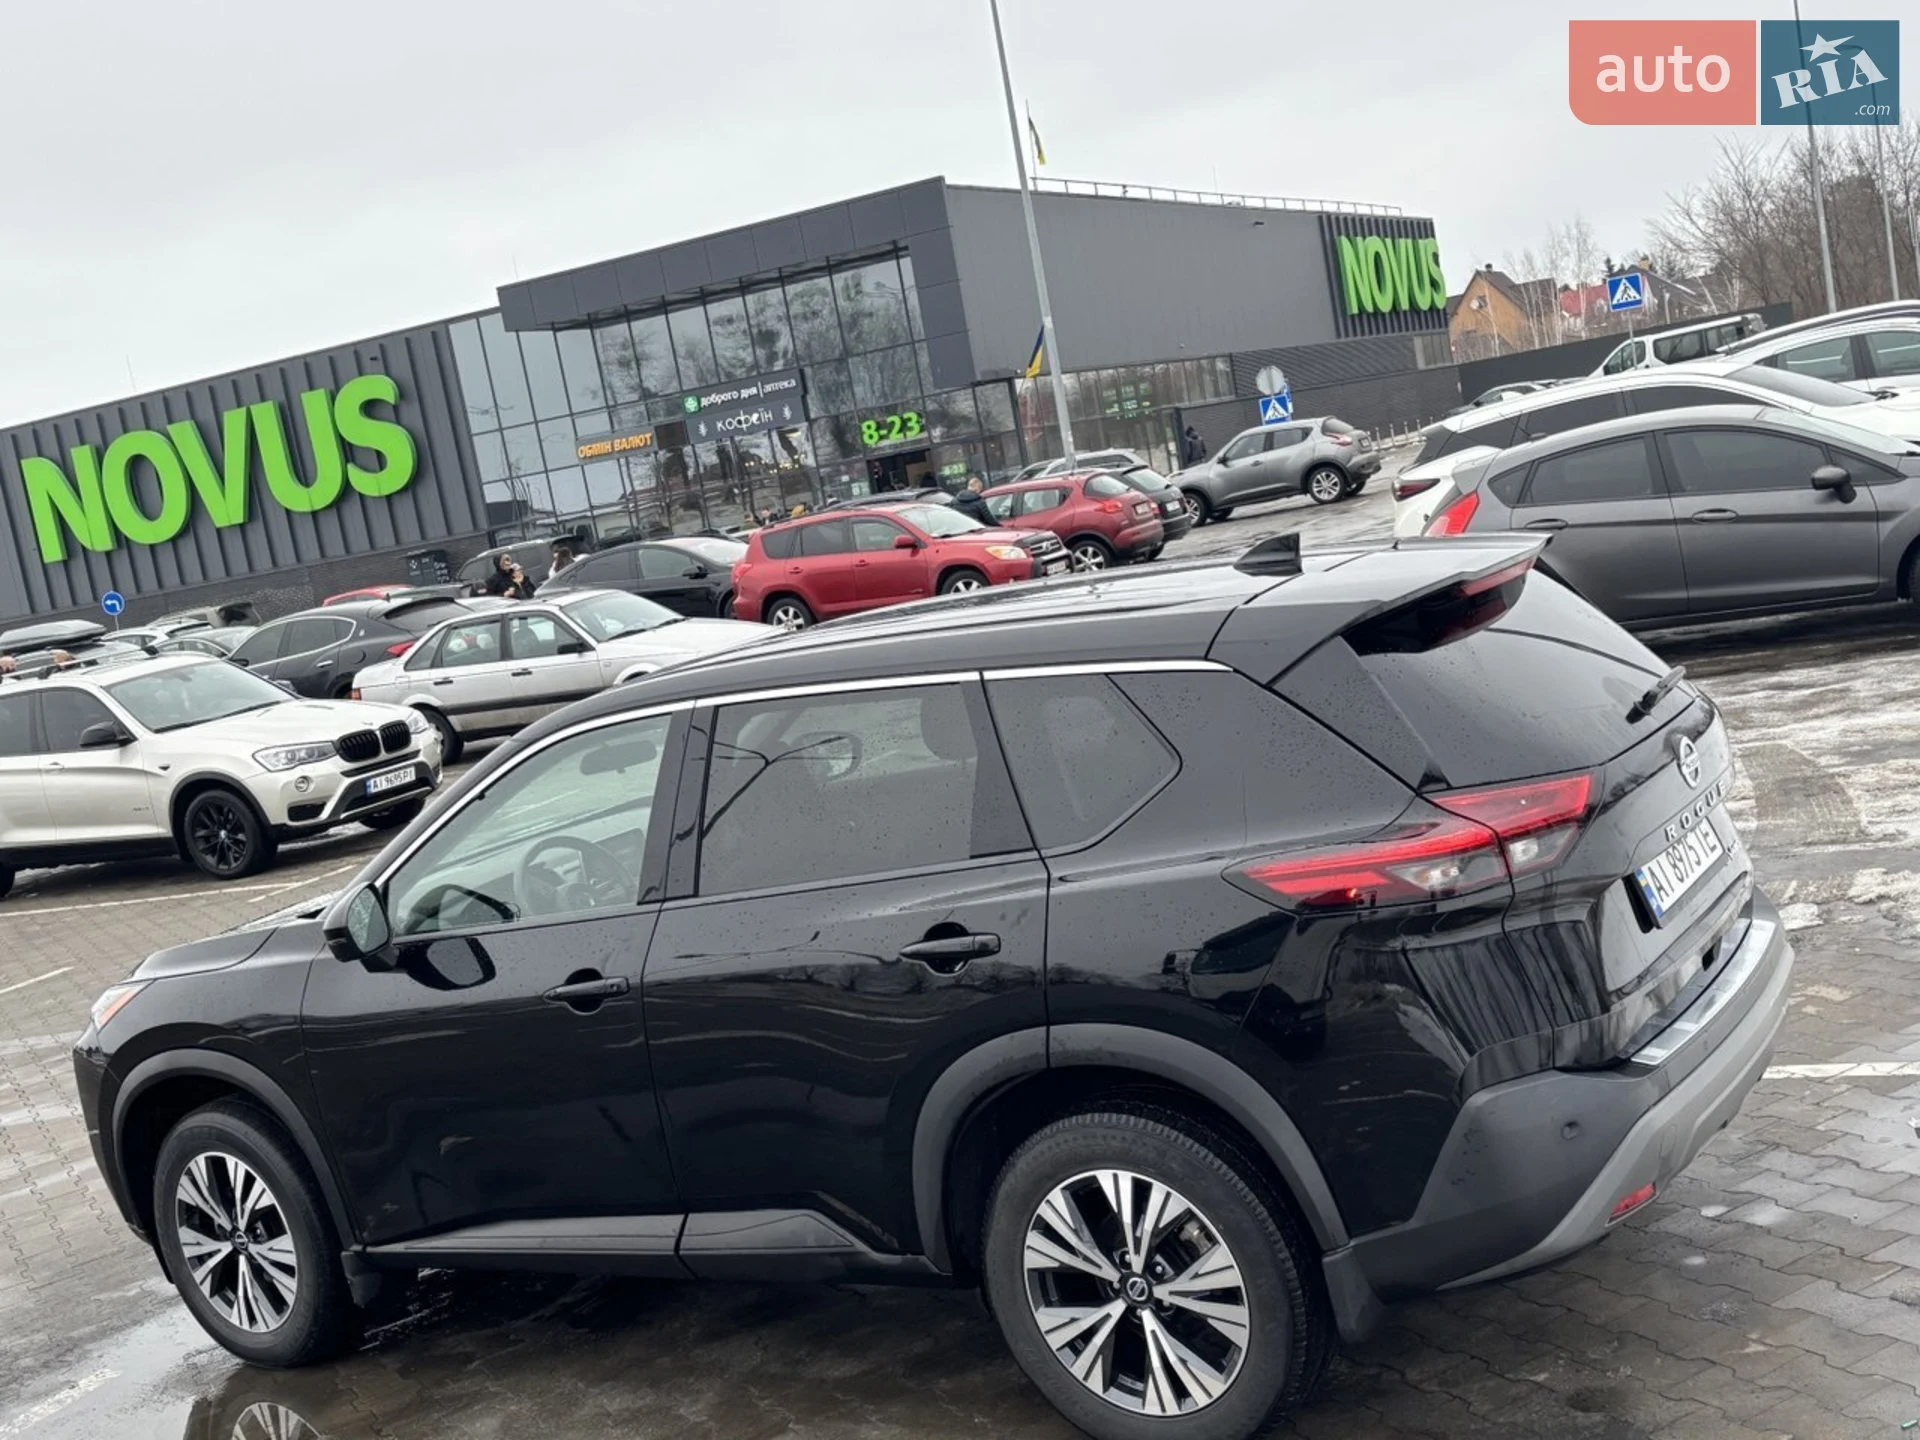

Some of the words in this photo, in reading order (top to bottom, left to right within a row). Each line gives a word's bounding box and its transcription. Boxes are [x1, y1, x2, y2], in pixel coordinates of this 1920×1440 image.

[1337, 235, 1446, 315] NOVUS
[578, 440, 612, 459] ОБМІН
[614, 432, 653, 453] ВАЛЮТ
[861, 411, 921, 445] 8-23
[20, 374, 417, 564] NOVUS
[1664, 781, 1725, 842] ROGUE
[1648, 859, 1675, 902] AI
[1666, 833, 1701, 883] 8975
